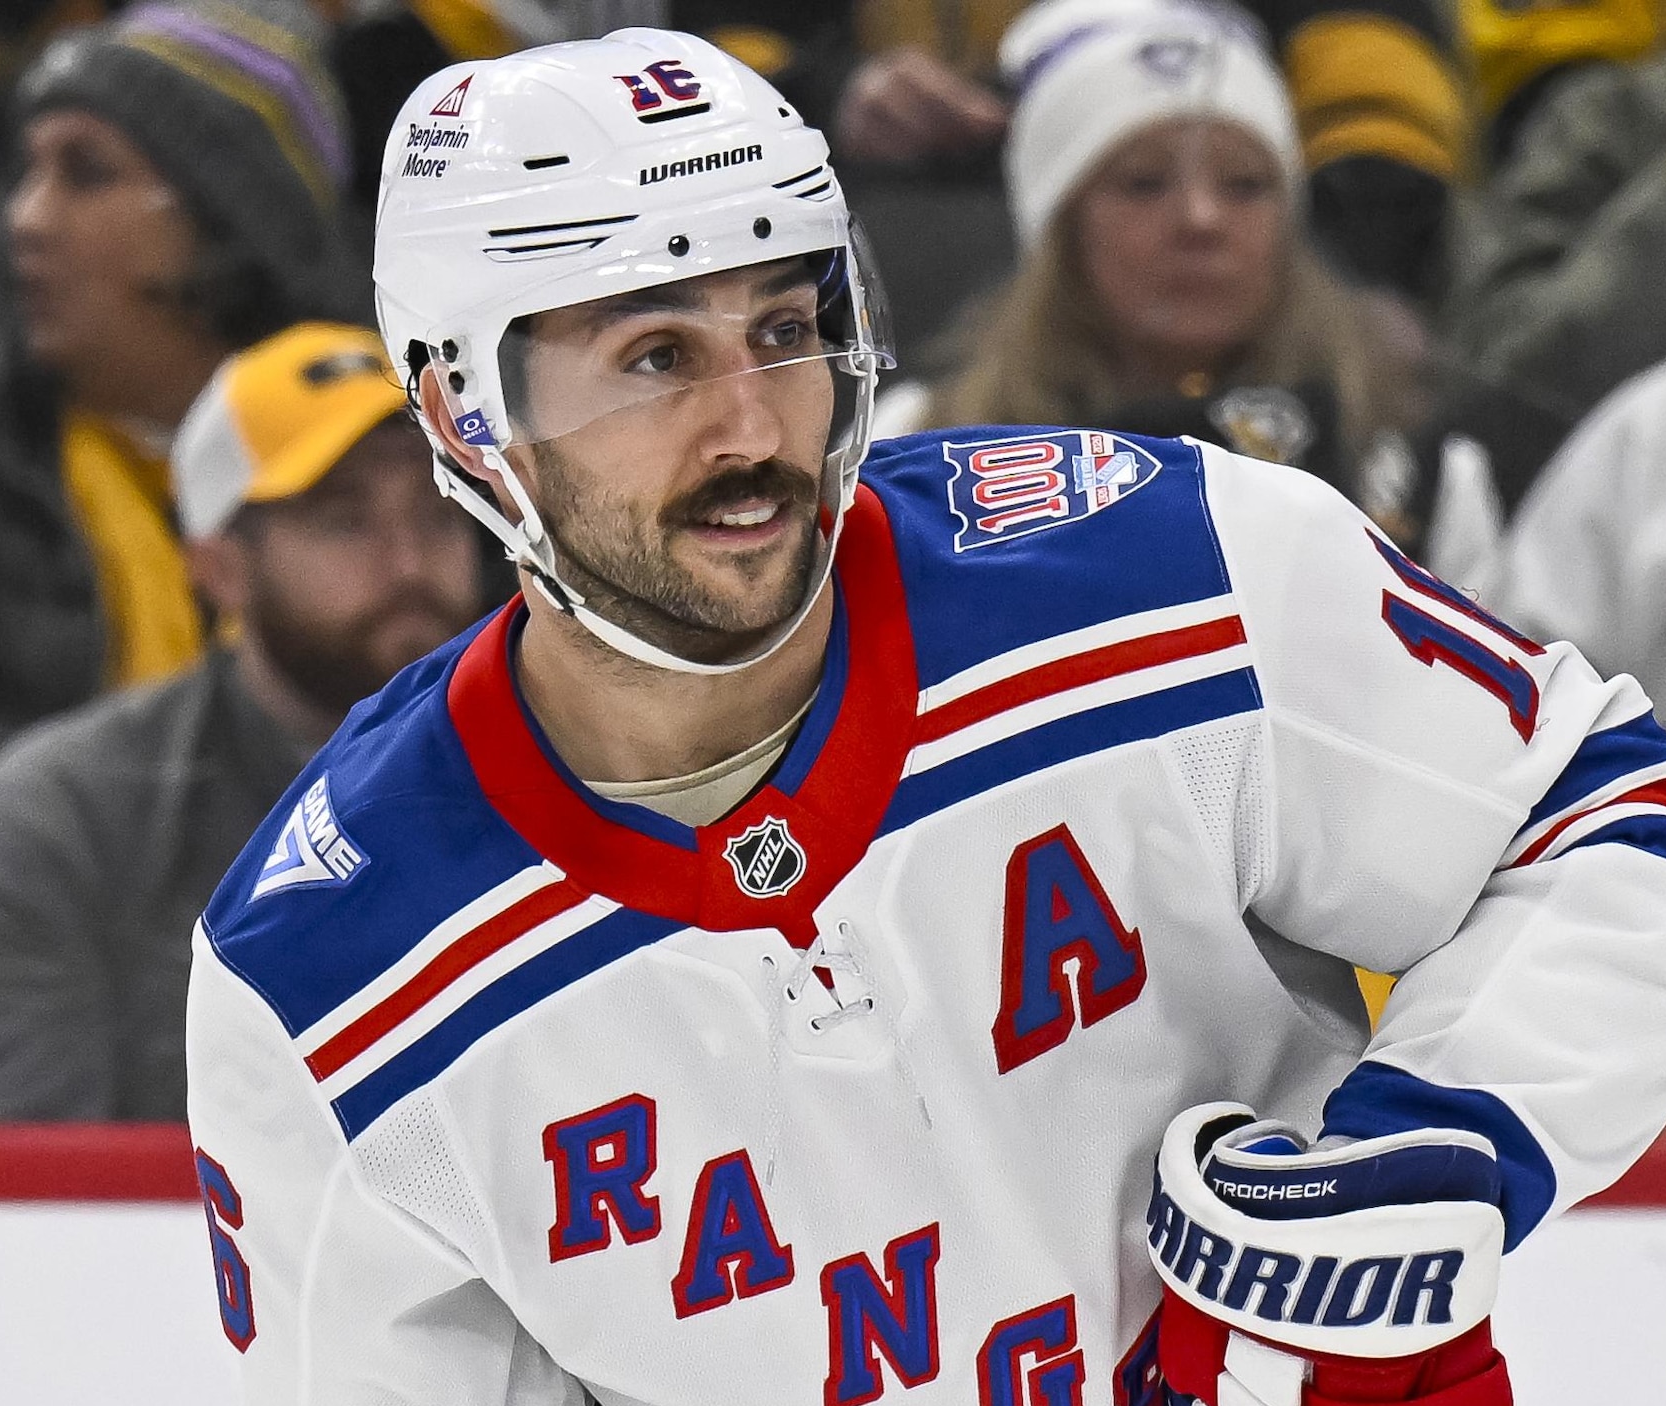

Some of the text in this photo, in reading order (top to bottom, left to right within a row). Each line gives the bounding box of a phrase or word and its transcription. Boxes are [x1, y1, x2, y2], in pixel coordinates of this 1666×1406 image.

[613, 60, 702, 112] 16
[406, 121, 470, 153] Benjamin
[401, 152, 447, 178] Moore
[639, 143, 763, 186] WARRIOR
[970, 441, 1069, 534] 100
[302, 773, 363, 880] GAME
[751, 837, 782, 887] NHL
[992, 822, 1147, 1075] A
[1212, 1177, 1338, 1200] TROCHECK
[1146, 1192, 1465, 1328] ARRIOR
